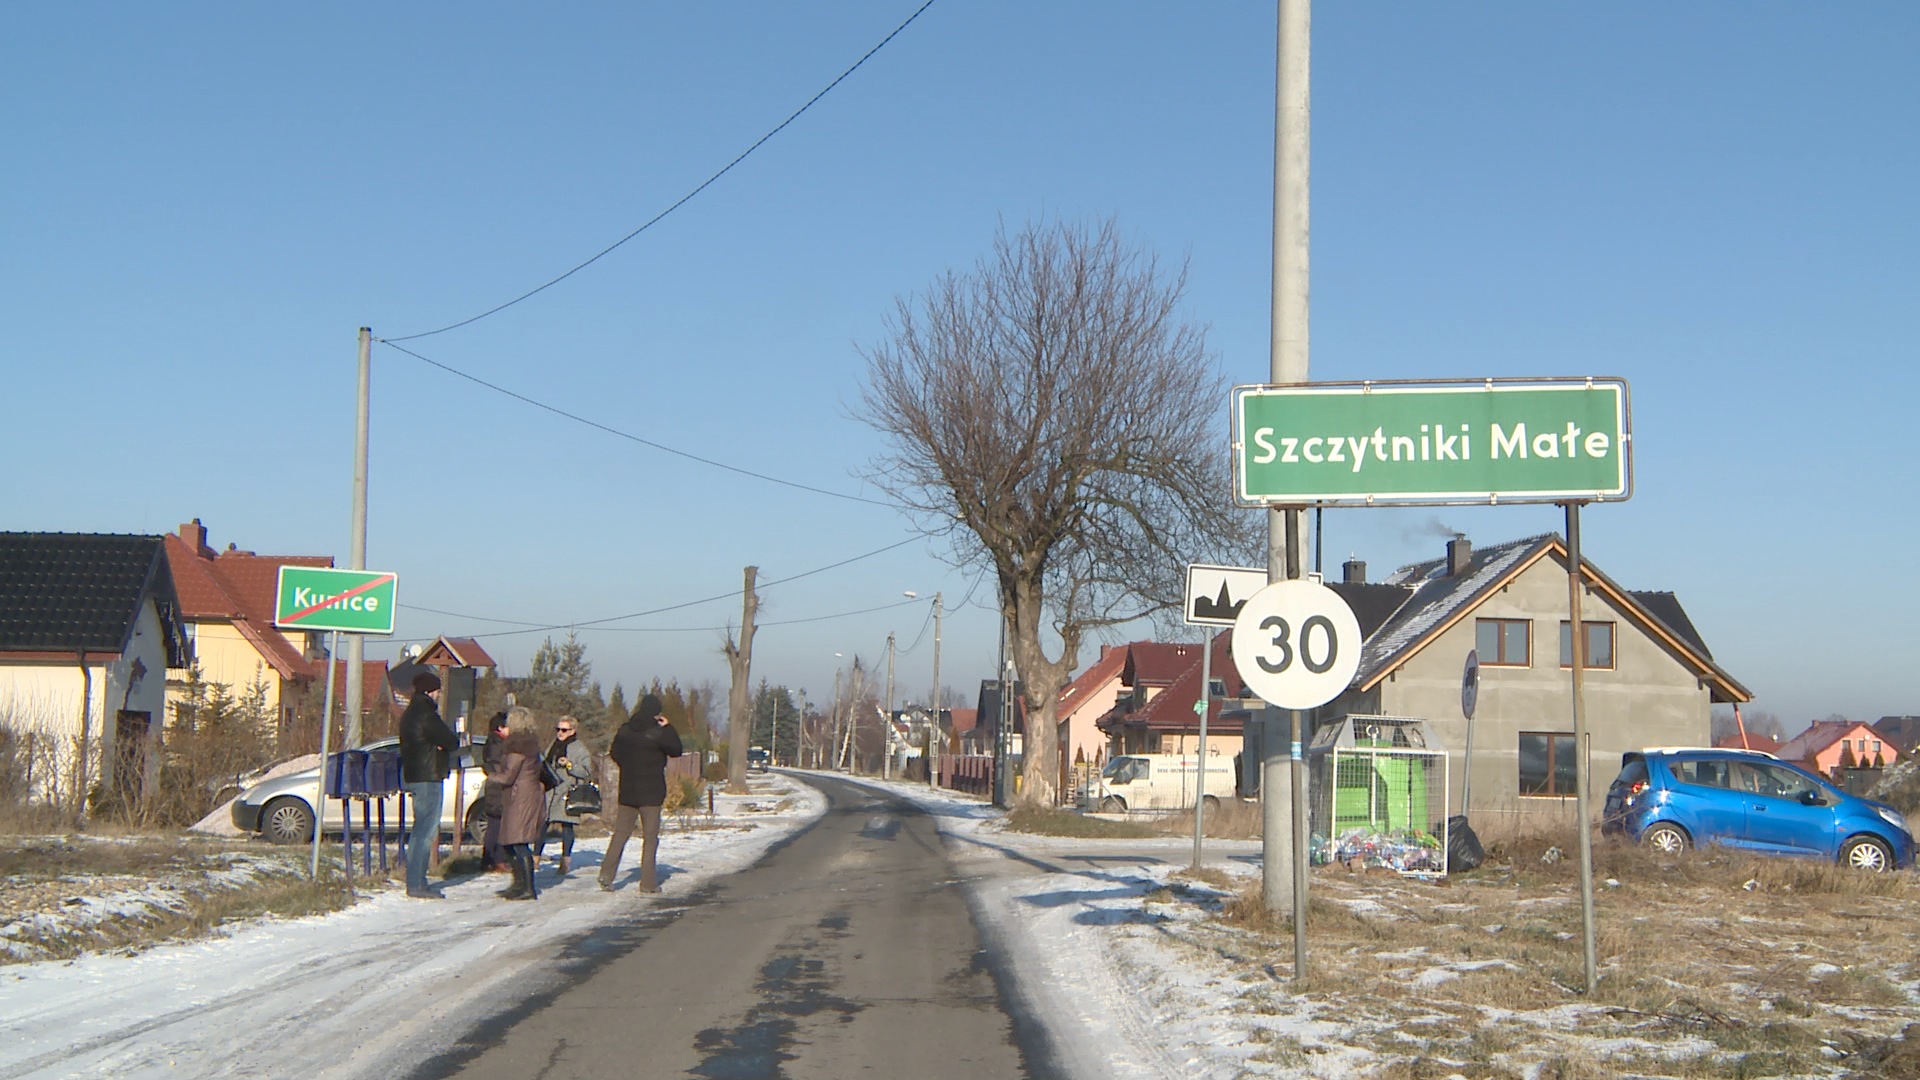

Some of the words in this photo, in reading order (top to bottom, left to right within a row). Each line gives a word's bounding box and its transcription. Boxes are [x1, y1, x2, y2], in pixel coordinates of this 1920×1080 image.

[1253, 423, 1470, 473] Szczytniki
[1490, 421, 1610, 460] Małe
[294, 586, 378, 612] Kunice
[1255, 614, 1338, 674] 30
